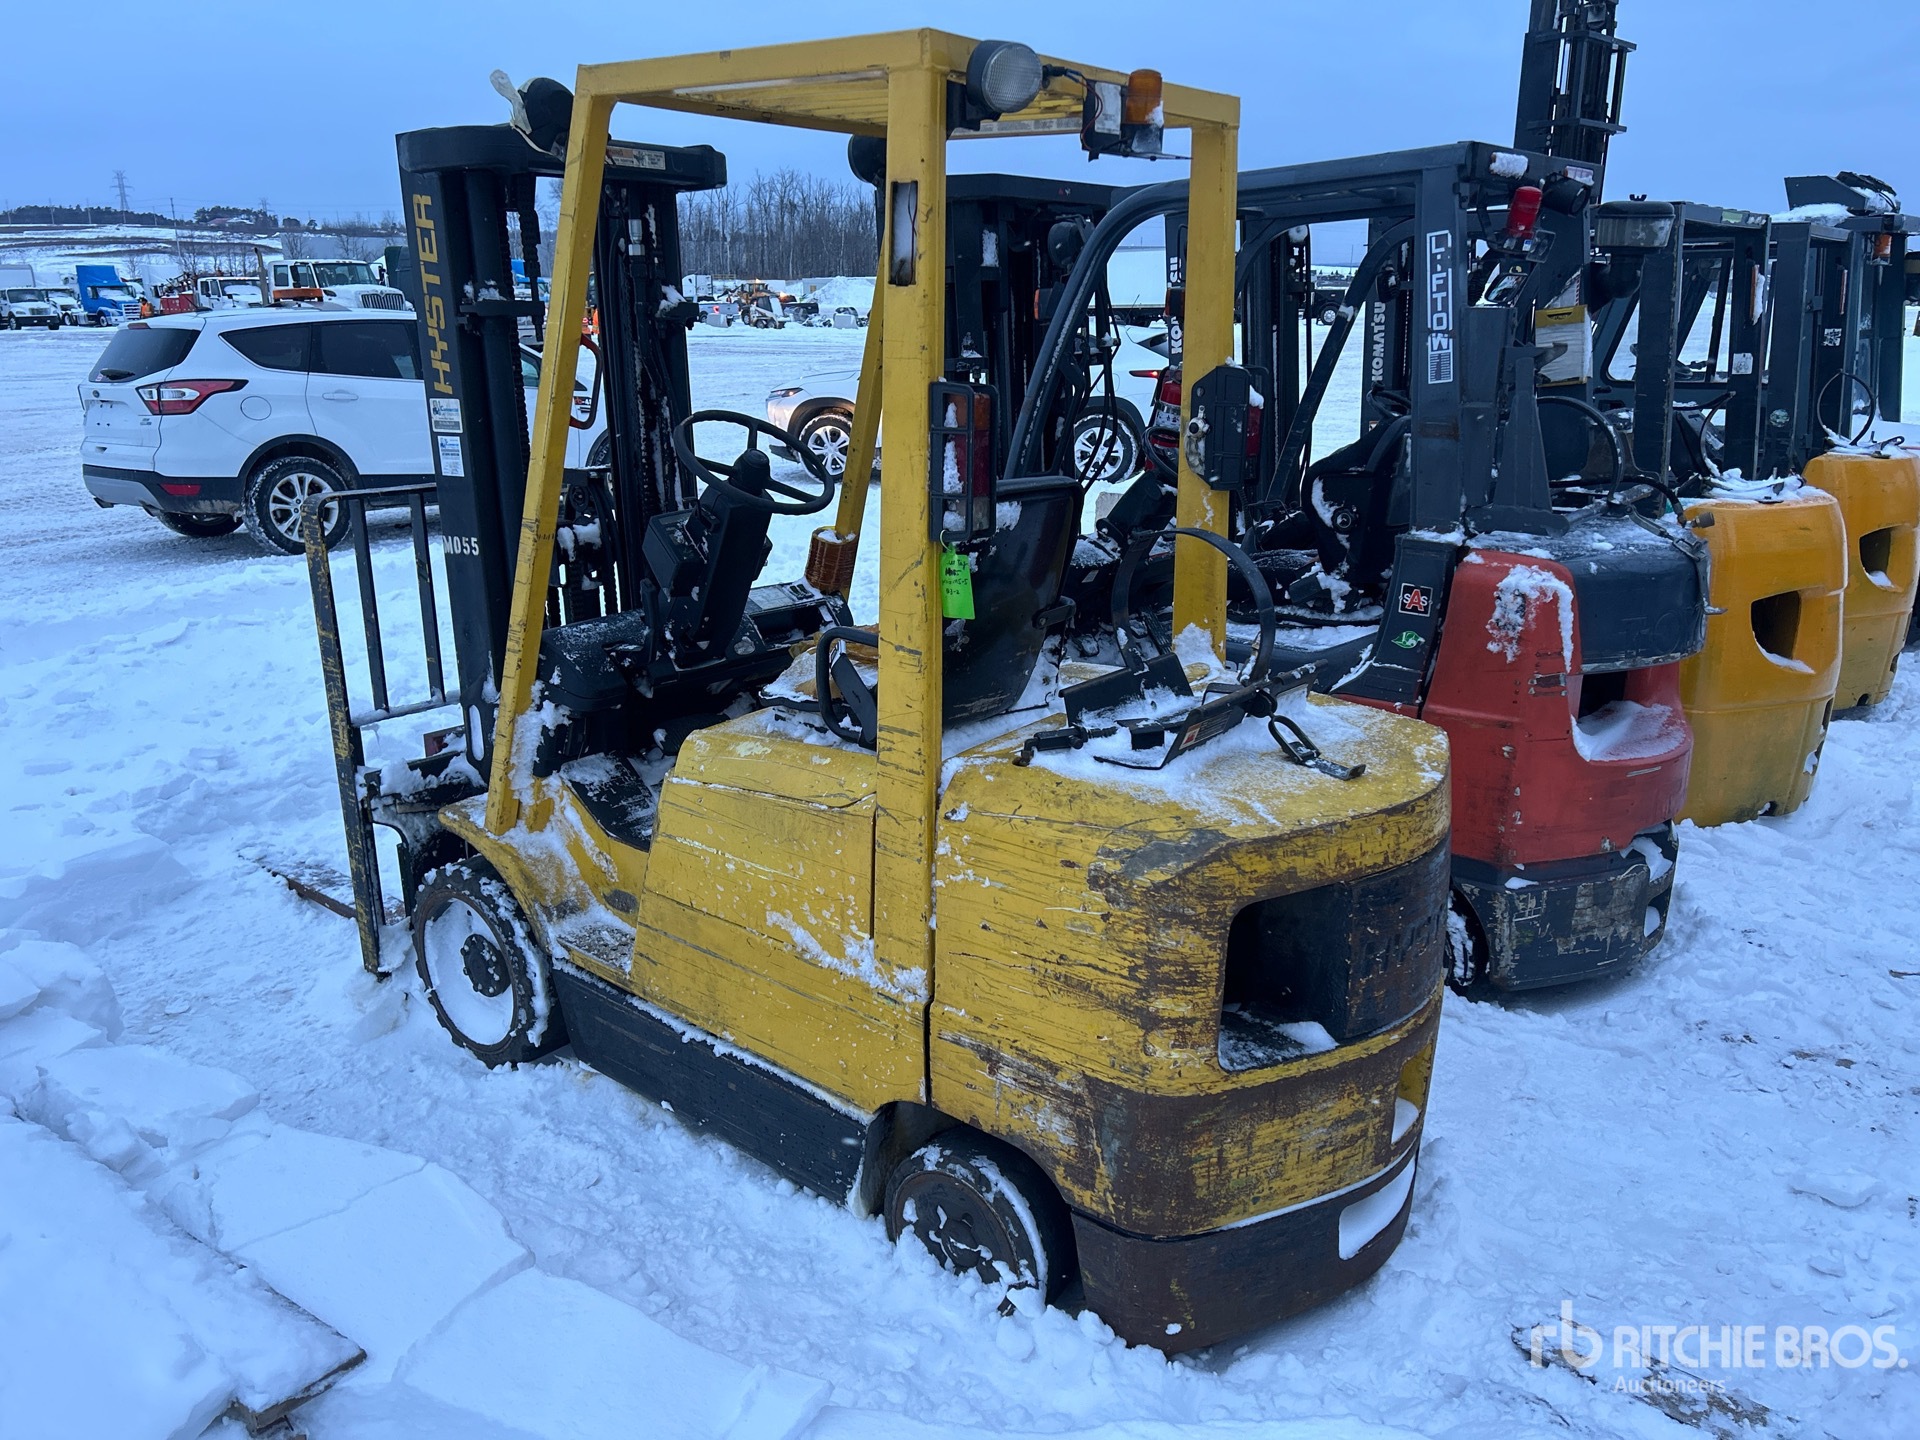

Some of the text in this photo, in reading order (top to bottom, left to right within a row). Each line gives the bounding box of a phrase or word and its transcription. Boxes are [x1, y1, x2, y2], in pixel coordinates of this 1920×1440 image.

[412, 193, 453, 395] HYSTER
[1371, 301, 1387, 382] KOMATSU
[1431, 235, 1449, 351] LIFTOW
[1403, 588, 1428, 611] SAS
